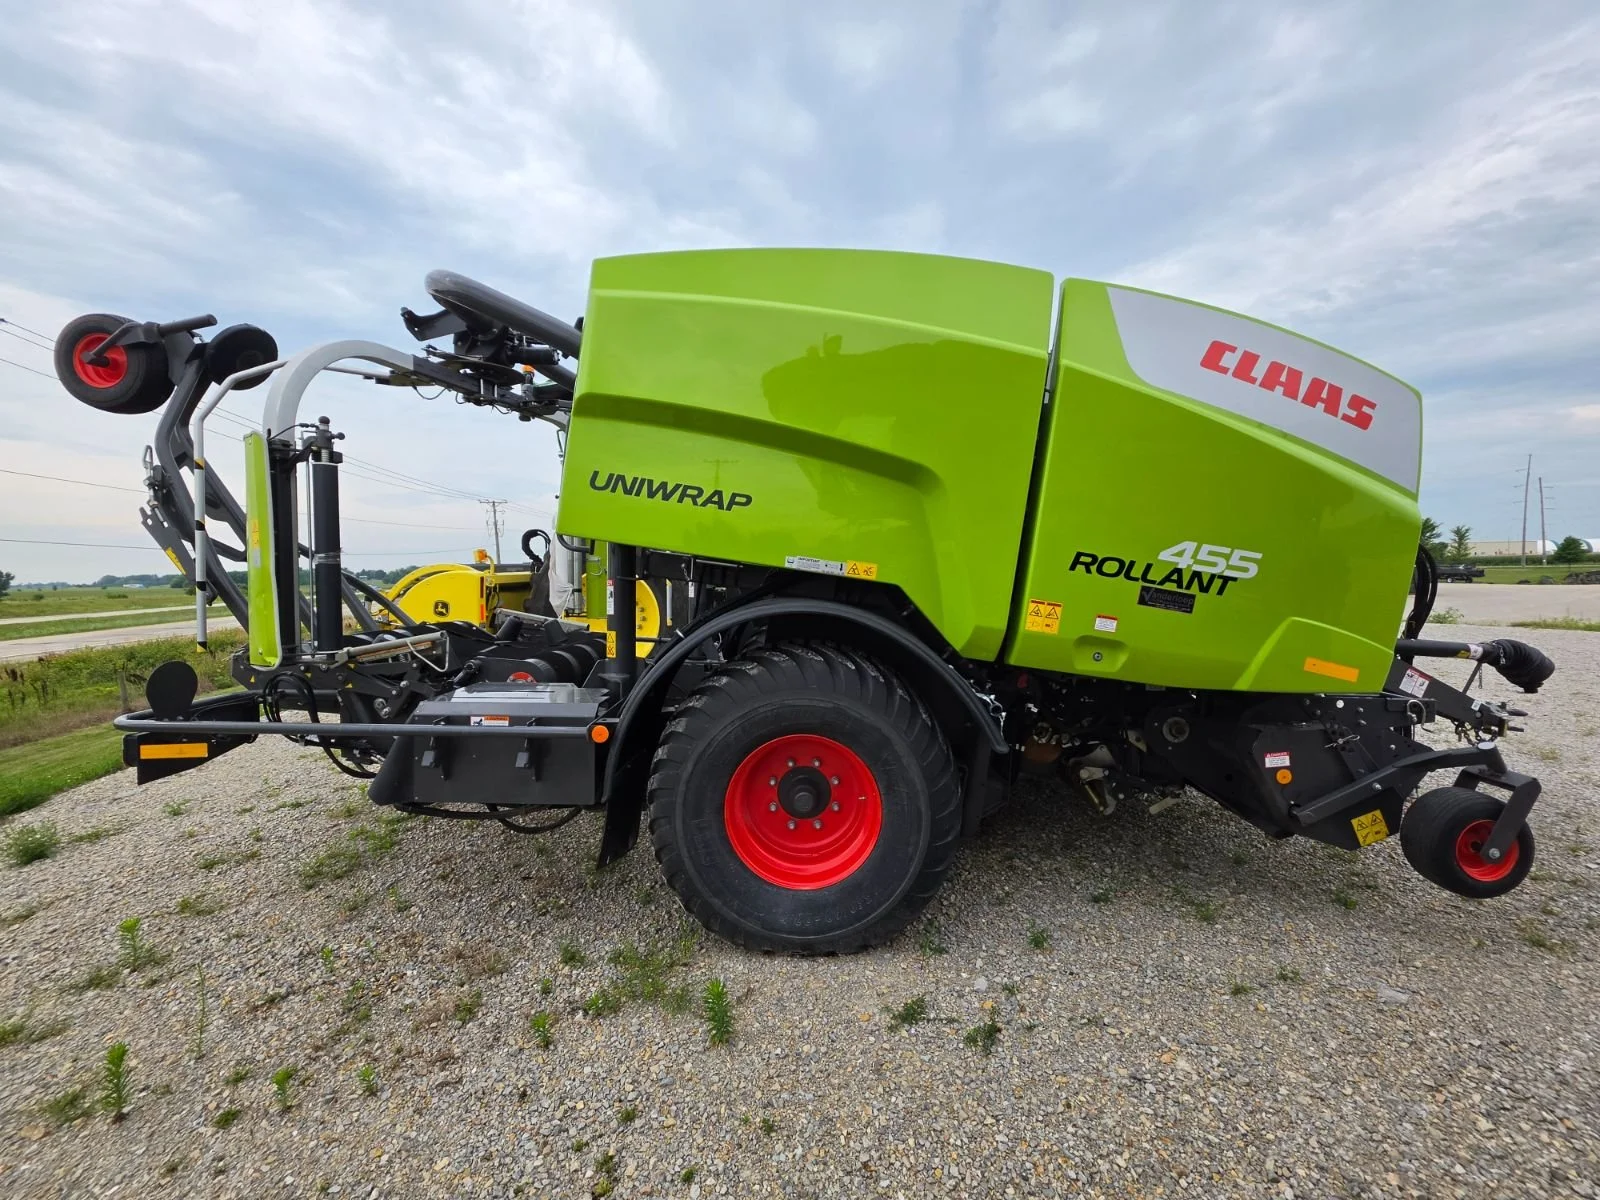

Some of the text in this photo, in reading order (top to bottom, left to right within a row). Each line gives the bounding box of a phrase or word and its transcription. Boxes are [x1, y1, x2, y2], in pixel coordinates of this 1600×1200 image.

[1200, 340, 1377, 431] CLAAS
[589, 470, 752, 511] UNIWRAP
[1069, 551, 1238, 596] ROLLANT
[1157, 540, 1263, 579] 455
